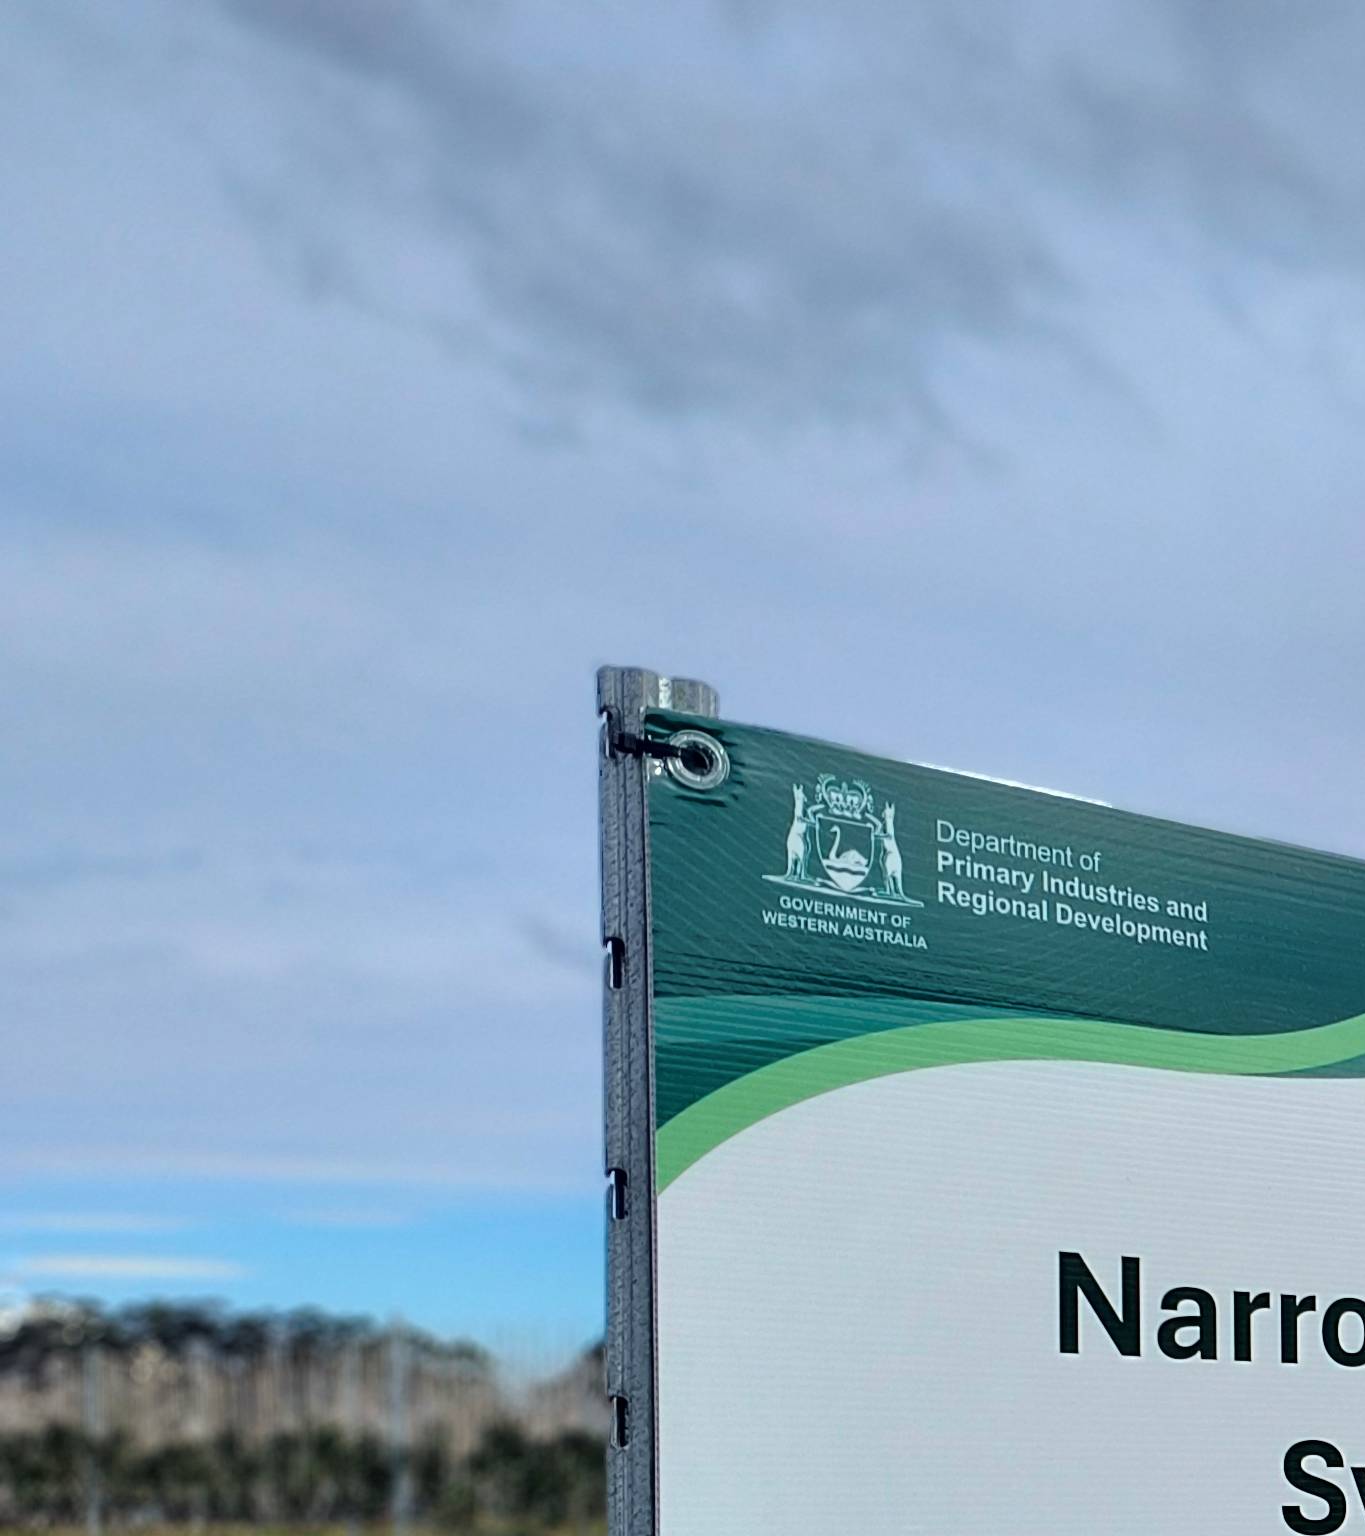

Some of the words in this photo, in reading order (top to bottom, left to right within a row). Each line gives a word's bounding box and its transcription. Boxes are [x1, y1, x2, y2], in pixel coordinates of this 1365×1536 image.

[937, 819, 1073, 869] Department
[1080, 852, 1102, 873] of
[780, 896, 887, 925] GOVERNMENT
[891, 914, 911, 929] OF
[937, 850, 1035, 893] Primary
[1043, 870, 1160, 913] Industries
[1166, 899, 1208, 923] and
[762, 910, 839, 935] WESTERN
[843, 924, 928, 950] AUSTRALIA
[937, 881, 1048, 922] Regional
[1056, 902, 1208, 951] Development
